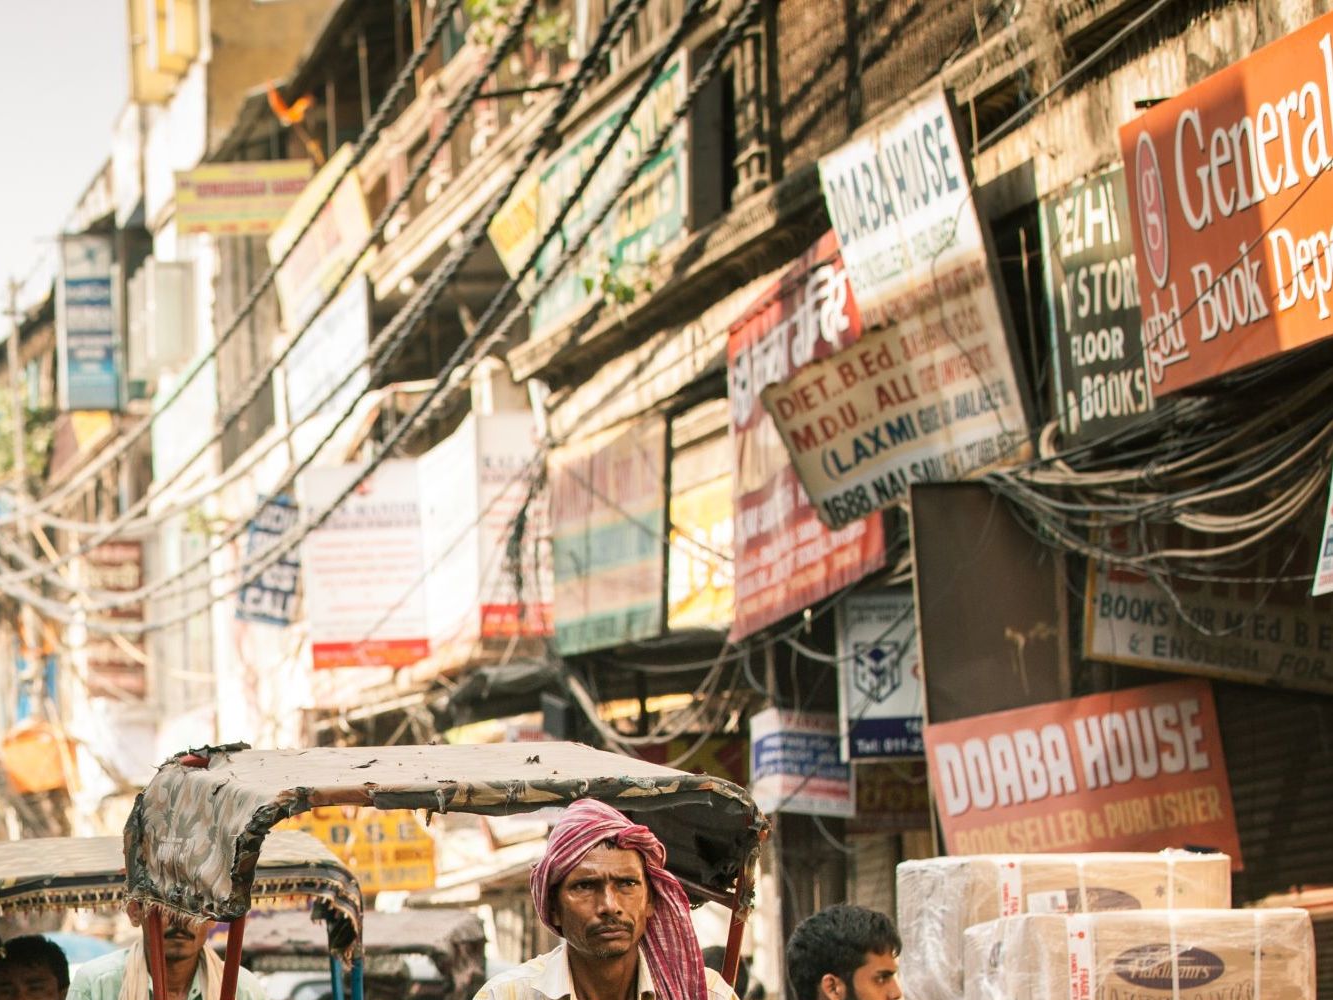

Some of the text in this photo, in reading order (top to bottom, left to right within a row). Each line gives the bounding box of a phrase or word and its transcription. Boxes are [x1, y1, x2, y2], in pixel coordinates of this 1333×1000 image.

[1191, 241, 1270, 342] Book
[1071, 326, 1125, 367] FLOOR
[875, 374, 918, 411] ALL
[1081, 367, 1147, 421] BOOKS
[1100, 592, 1167, 628] BOOKS
[934, 723, 1077, 817] DOABA
[1074, 699, 1210, 791] HOUSE
[956, 785, 1224, 855] BOOKSELLER & PUBLISHER
[1127, 958, 1212, 980] Haldiam's
